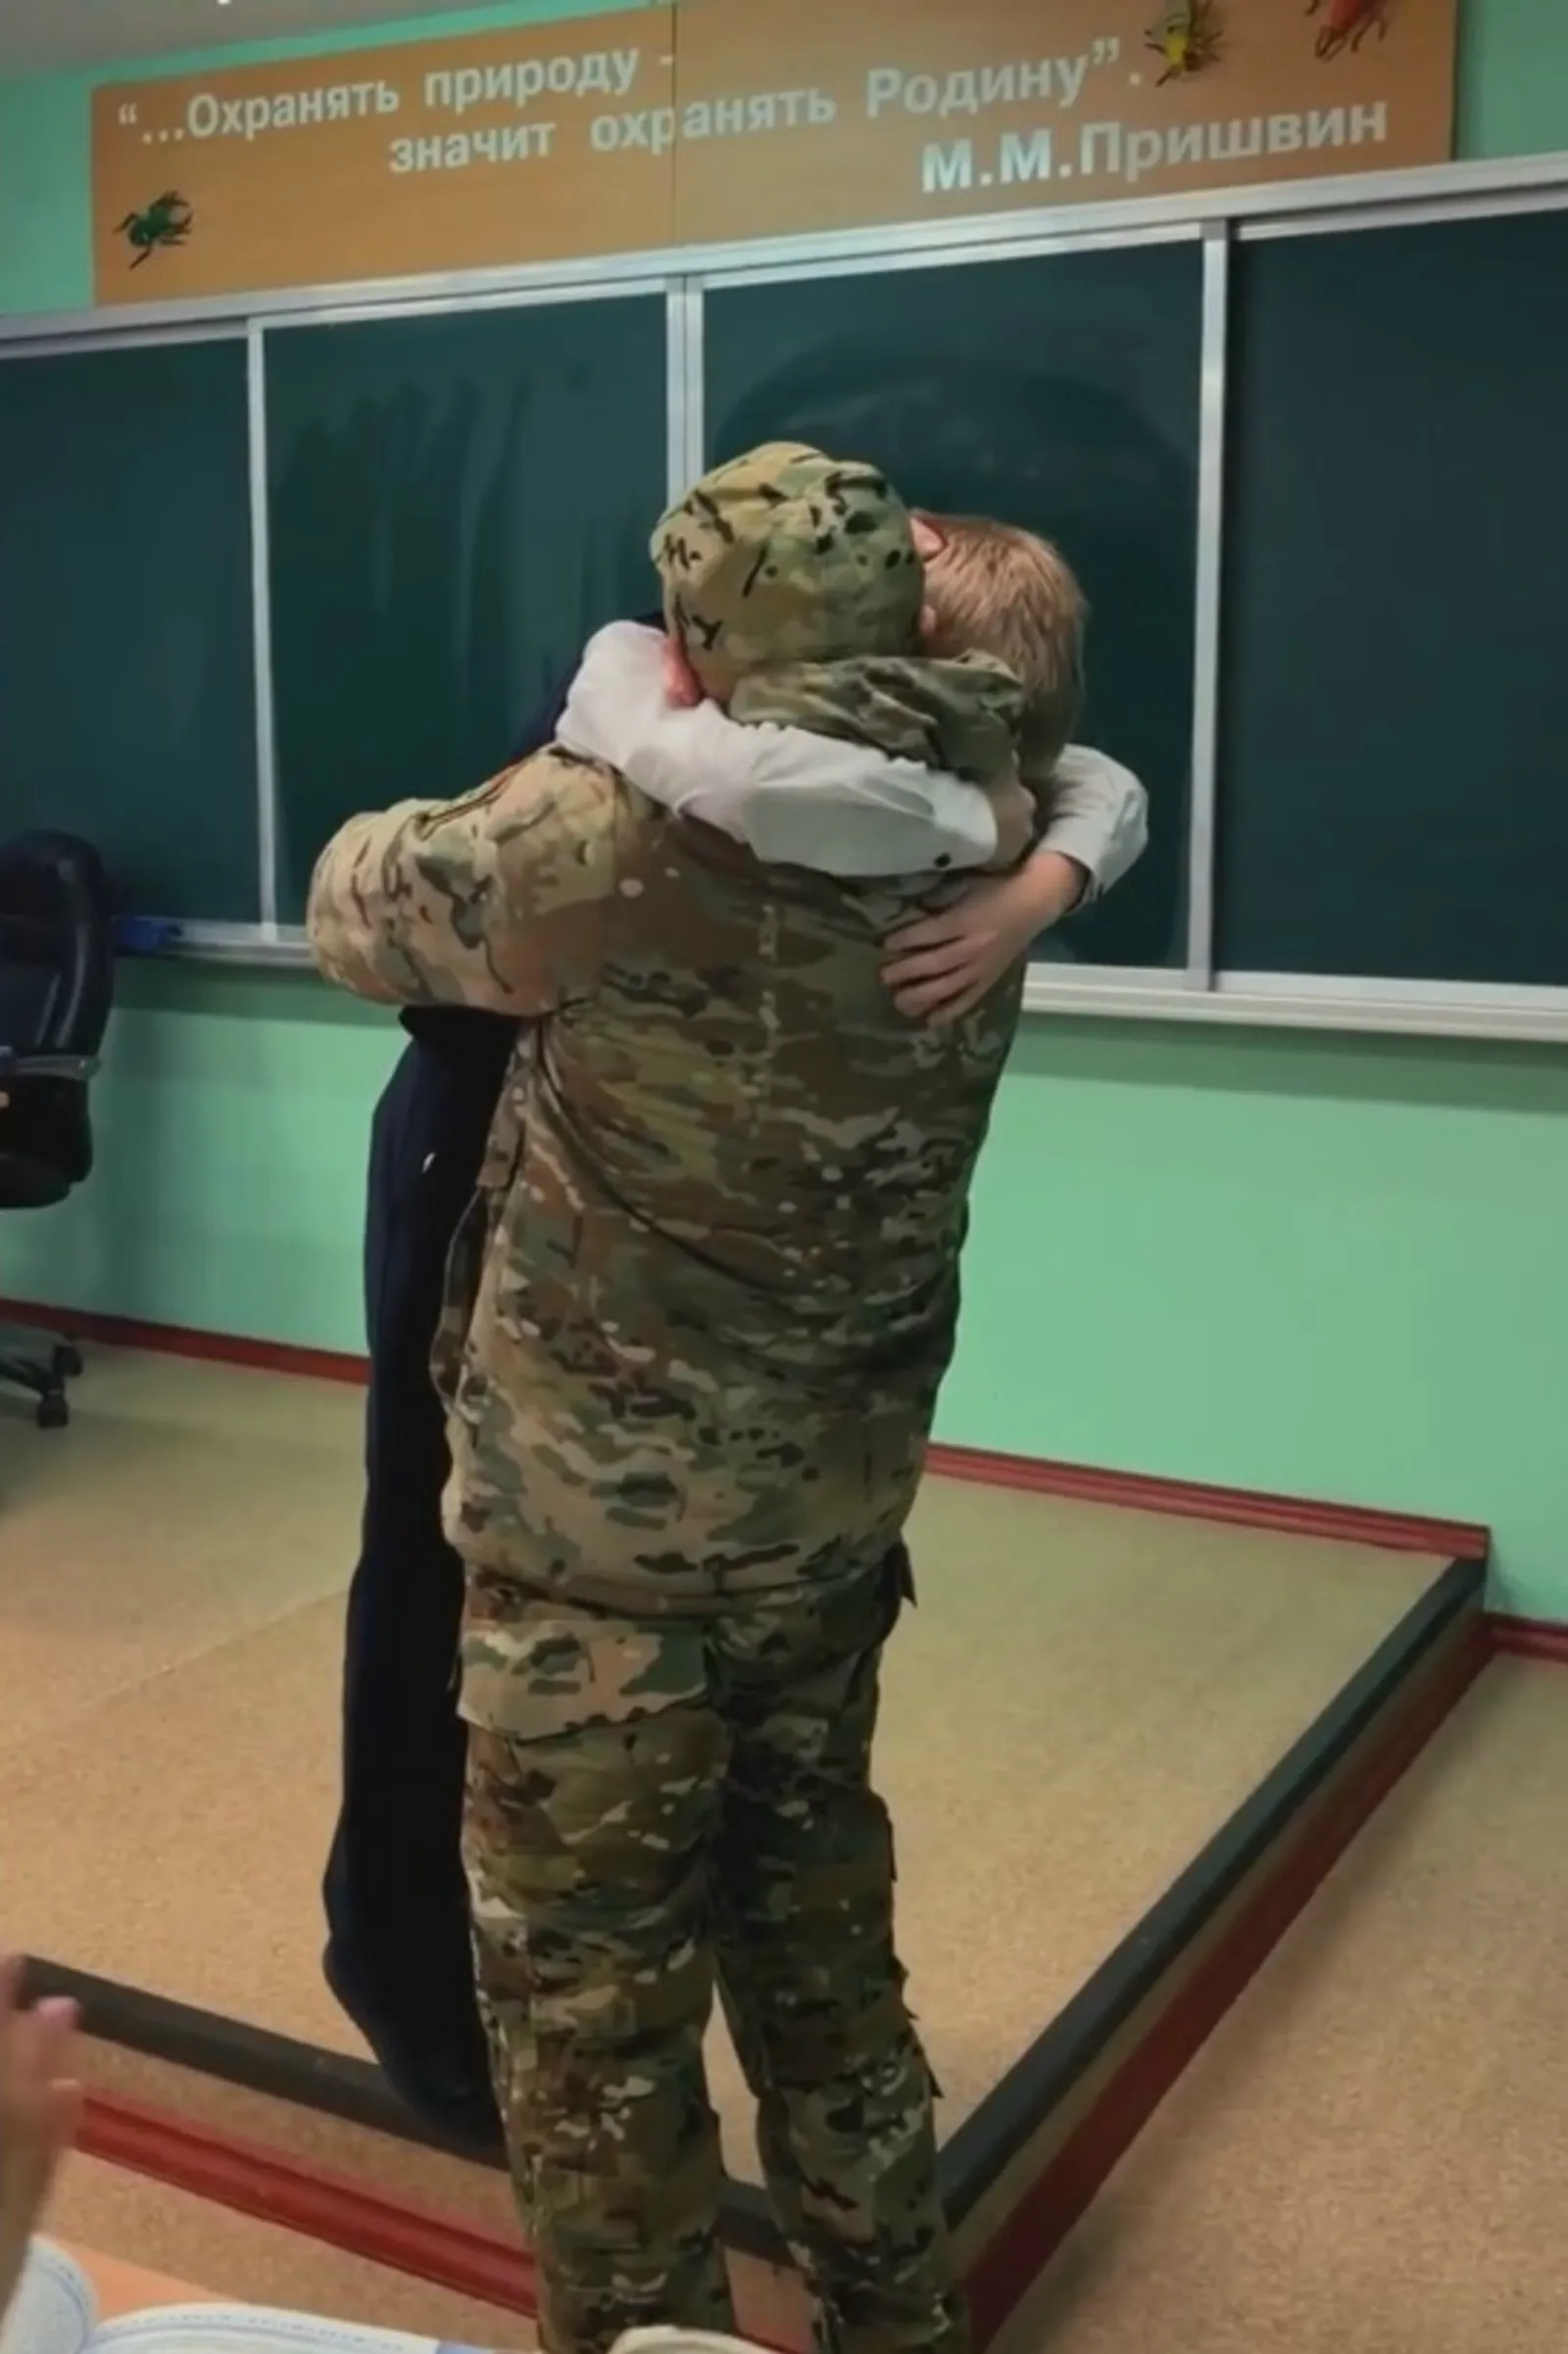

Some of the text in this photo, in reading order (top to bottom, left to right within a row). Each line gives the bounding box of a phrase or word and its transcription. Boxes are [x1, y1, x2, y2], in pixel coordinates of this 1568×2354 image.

[389, 37, 1142, 173] значит охранять Родину”.
[424, 48, 639, 114] природу
[922, 102, 1388, 193] М.М.Пришвин
